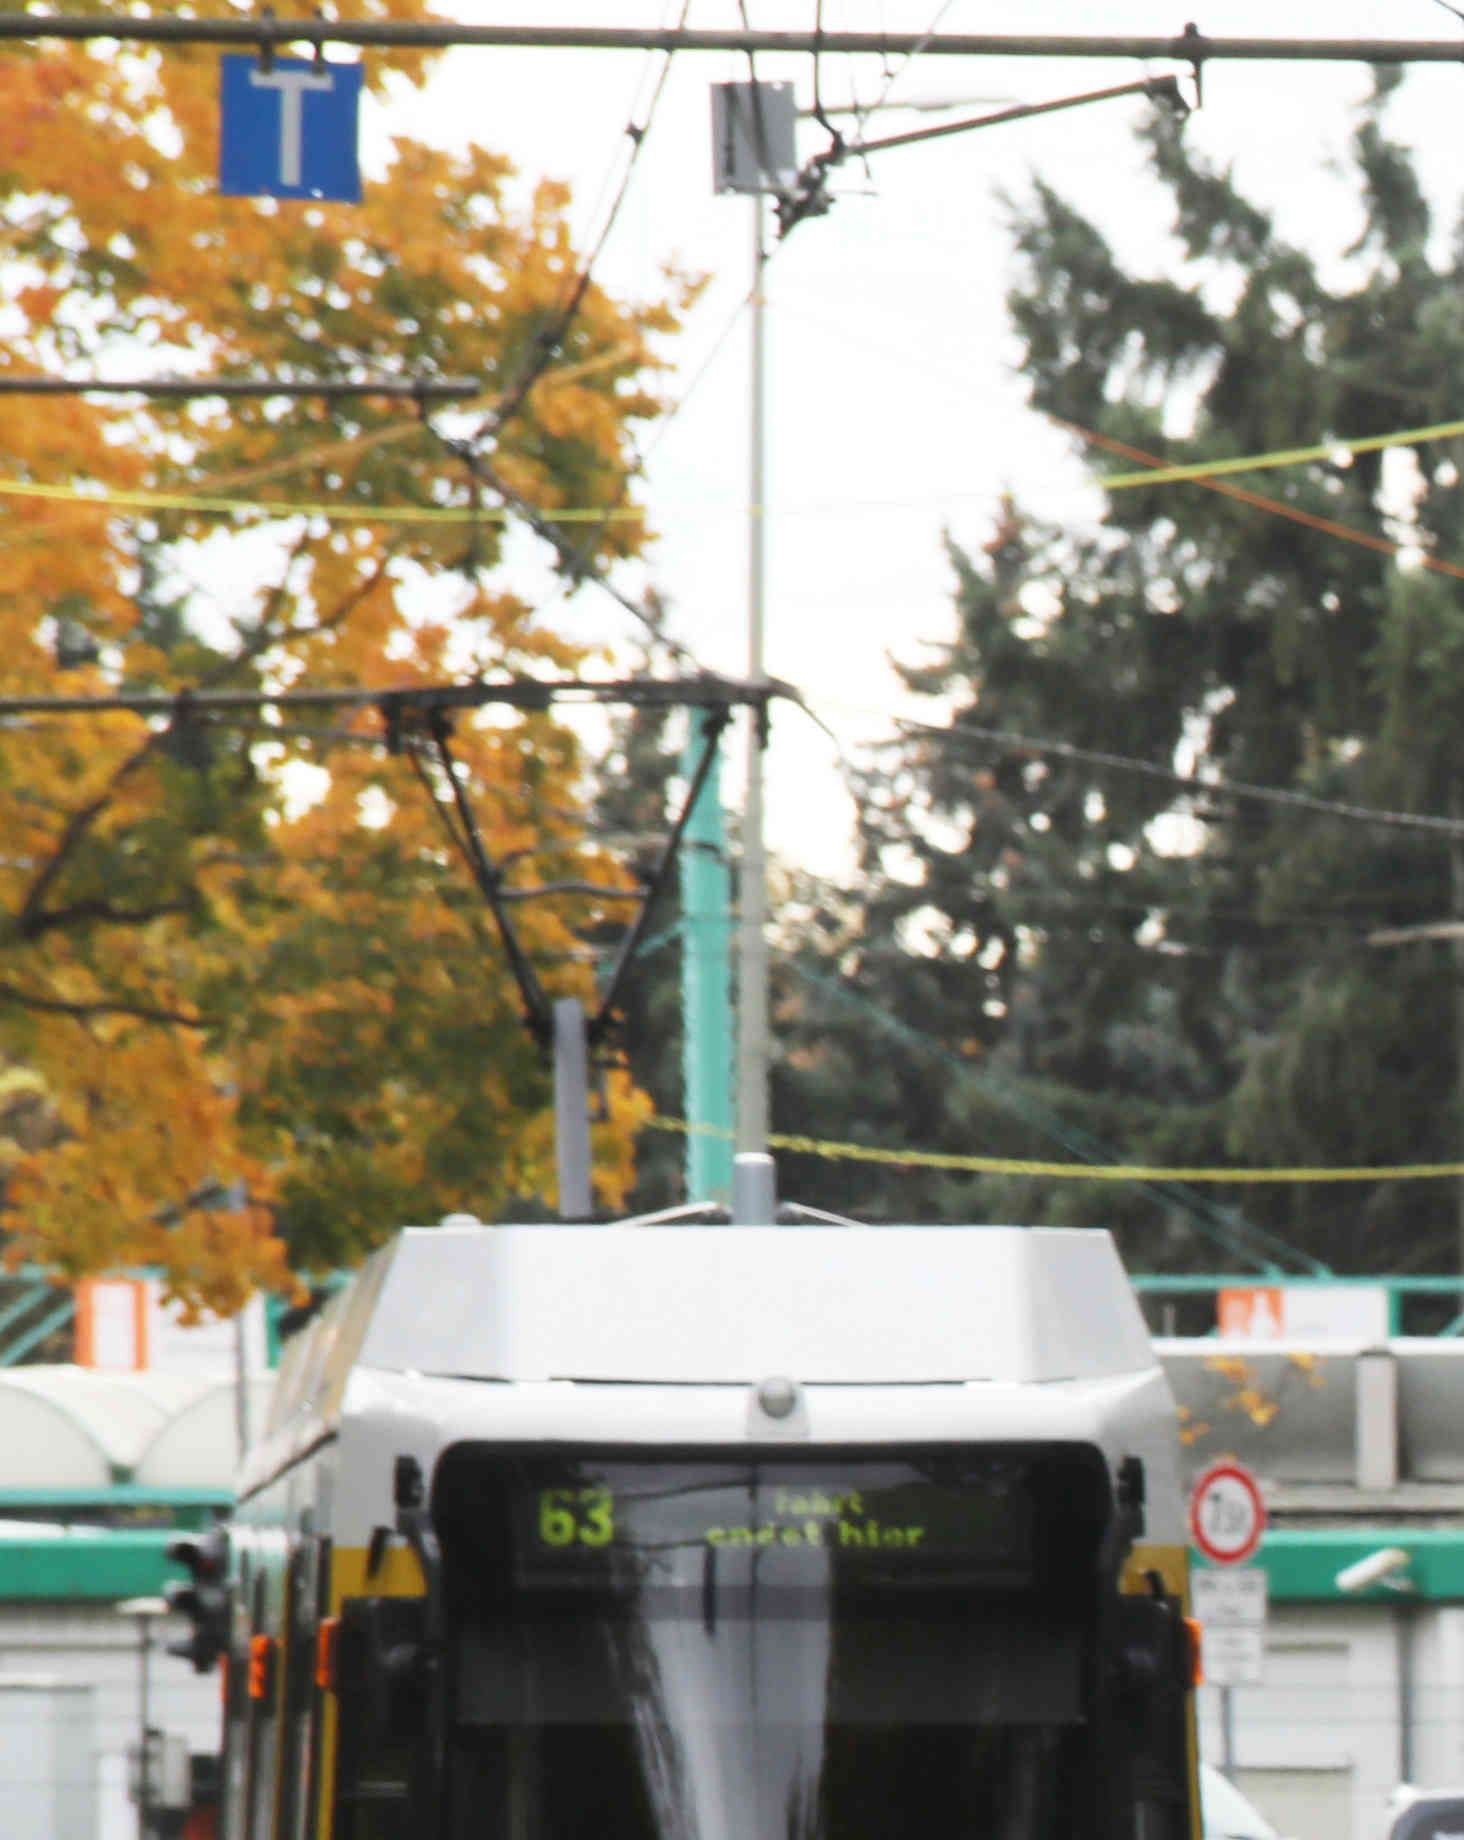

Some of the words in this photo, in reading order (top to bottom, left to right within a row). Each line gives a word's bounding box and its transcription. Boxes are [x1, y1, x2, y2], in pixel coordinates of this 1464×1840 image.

[249, 70, 334, 187] T
[538, 1488, 614, 1547] 63
[838, 1520, 926, 1548] hier
